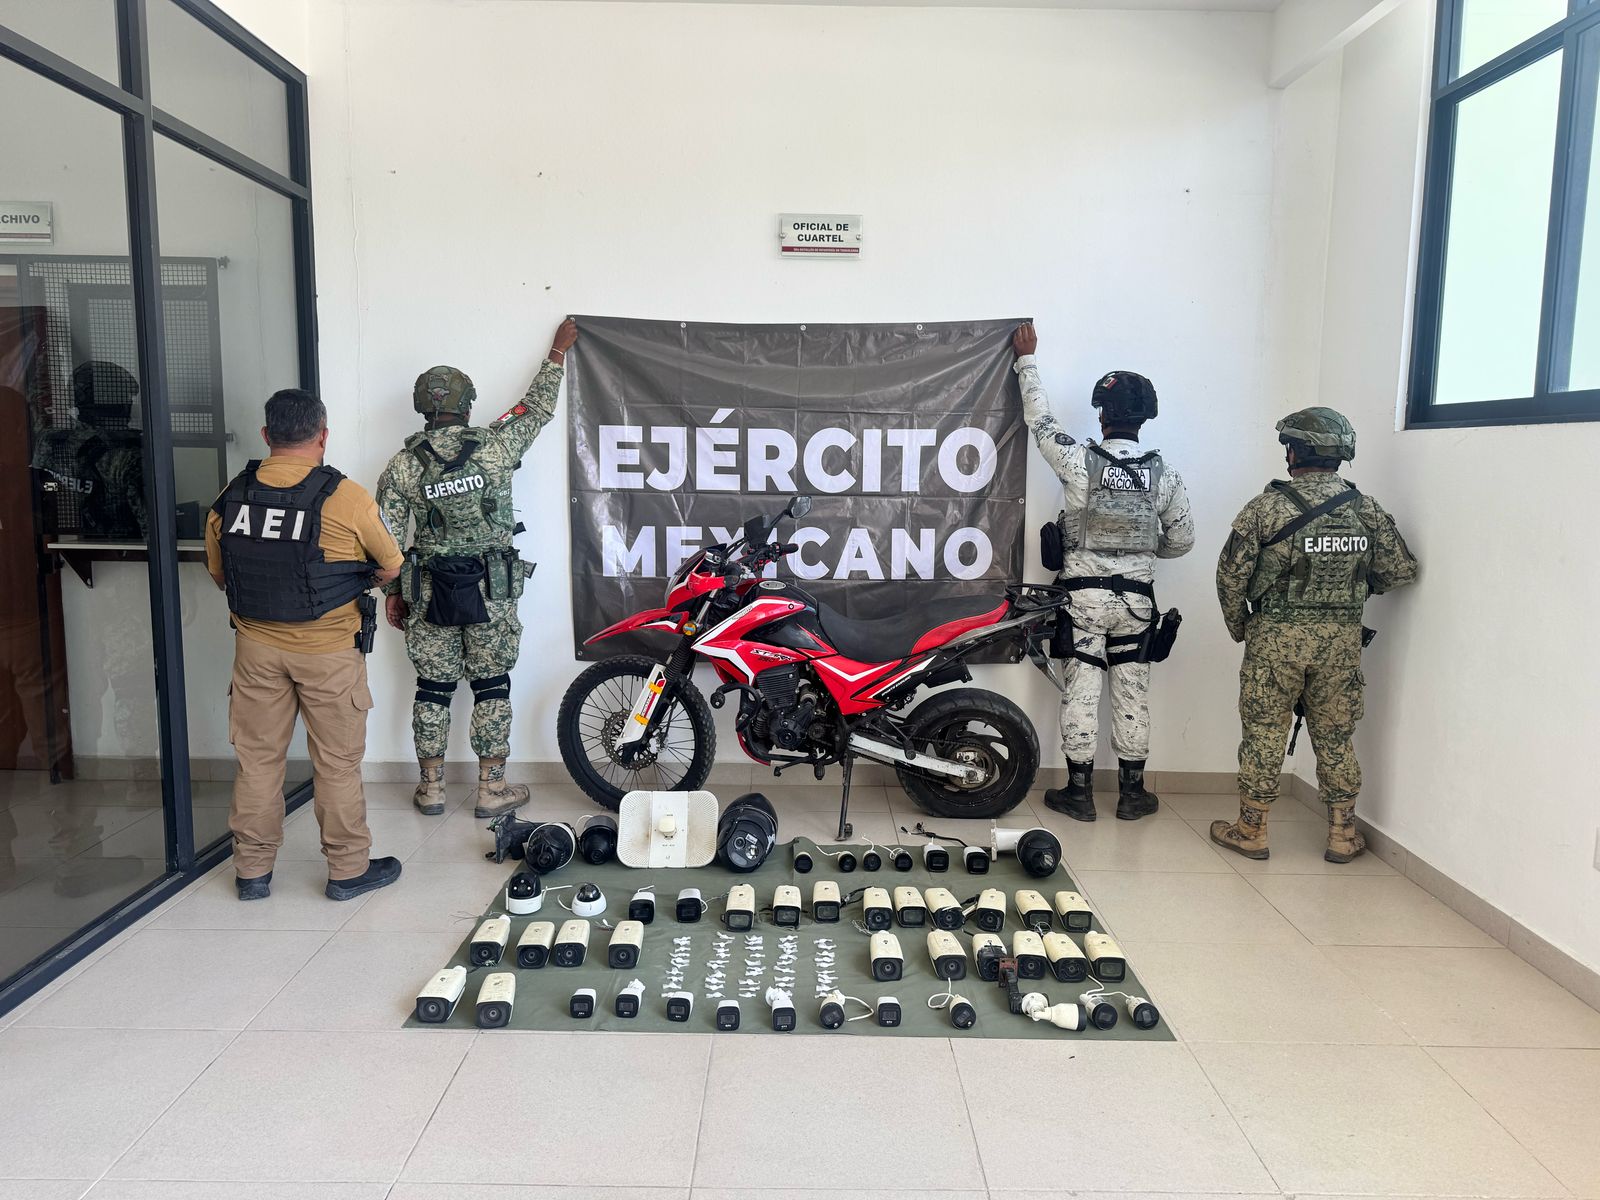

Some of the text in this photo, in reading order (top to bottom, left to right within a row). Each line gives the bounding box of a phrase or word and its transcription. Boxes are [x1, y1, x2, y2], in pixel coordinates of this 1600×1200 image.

[0, 214, 40, 224] CHIVO
[792, 222, 849, 231] OFICIAL DE
[797, 233, 844, 243] CUARTEL
[599, 408, 998, 493] EJÉRCITO
[1107, 467, 1146, 479] GUAA
[424, 474, 484, 500] EJERCITO
[1103, 477, 1148, 490] NACIONL
[228, 504, 305, 540] AEI
